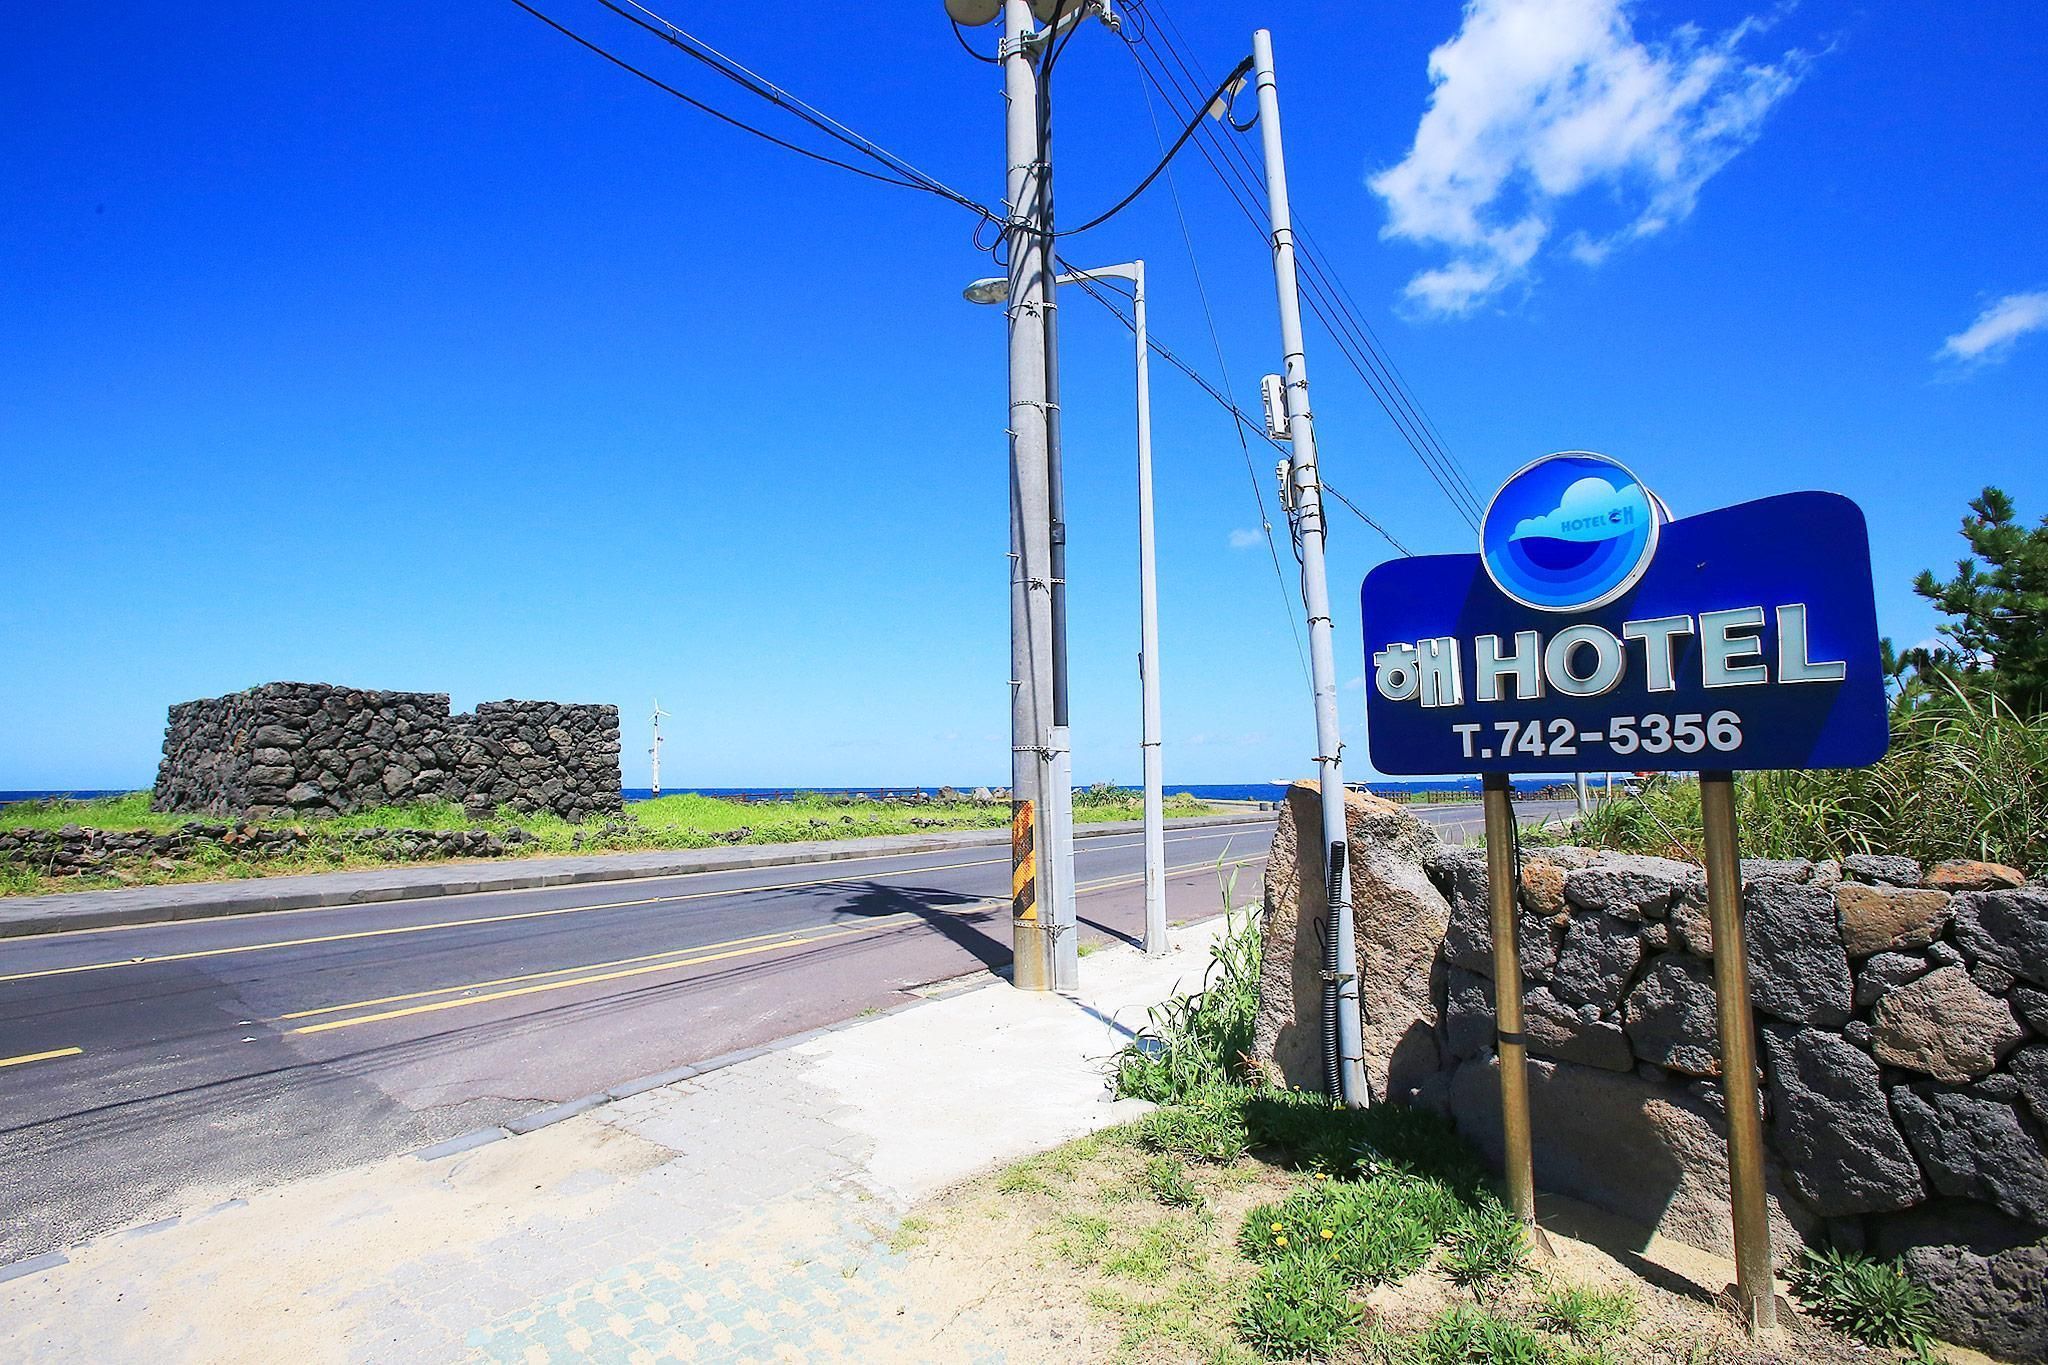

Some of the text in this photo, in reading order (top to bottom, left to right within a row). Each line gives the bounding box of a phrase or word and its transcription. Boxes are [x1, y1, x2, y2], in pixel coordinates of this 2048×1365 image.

[1561, 516, 1606, 532] HOTEL
[1374, 603, 1846, 707] 해 HOTEL
[1452, 711, 1743, 759] T.742-5356
